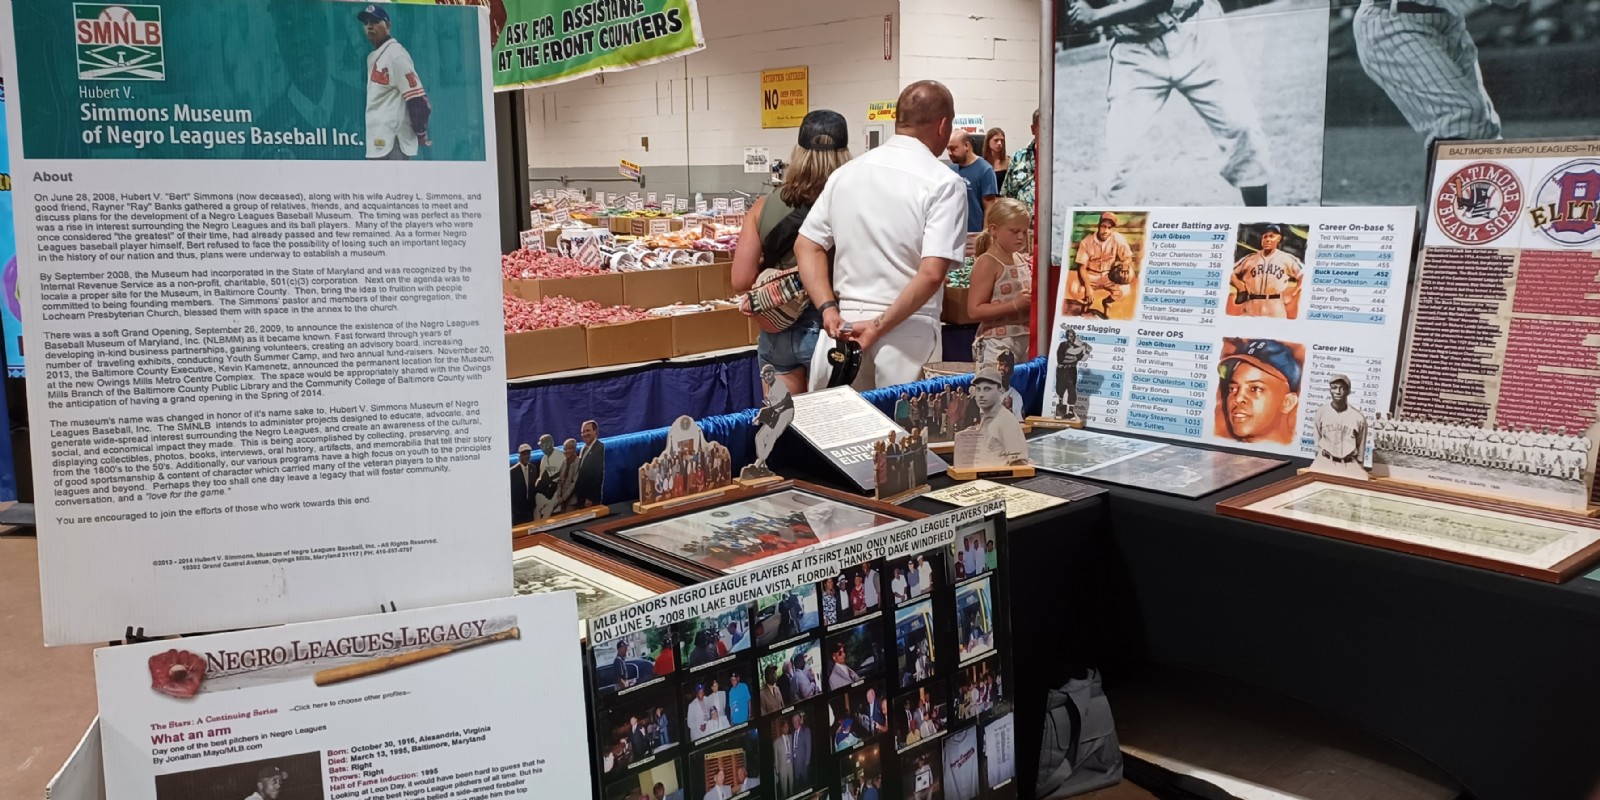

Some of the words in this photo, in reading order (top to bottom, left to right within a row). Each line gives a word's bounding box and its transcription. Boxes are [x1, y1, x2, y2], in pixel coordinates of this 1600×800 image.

[77, 20, 161, 45] SMNLB
[499, 50, 512, 71] AT
[517, 45, 539, 68] THE
[543, 31, 595, 64] FRONT
[600, 9, 683, 49] COUNTERS
[506, 22, 528, 46] ASK
[533, 16, 553, 40] FOR
[79, 85, 119, 99] Hubert
[122, 86, 135, 99] V.
[765, 89, 778, 110] NO
[80, 103, 169, 122] Simmons
[174, 104, 252, 122] Museum
[82, 125, 102, 144] of
[107, 126, 164, 148] Negro
[170, 126, 245, 149] Leagues
[251, 127, 326, 145] Baseball
[333, 128, 364, 146] Inc.
[1449, 147, 1502, 155] BALTIMORE'S
[33, 170, 73, 183] About
[1440, 166, 1520, 202] BALTIMORE
[1182, 222, 1212, 230] Batting
[1440, 207, 1478, 240] BLACK
[1486, 208, 1516, 235] SOX
[1251, 264, 1284, 279] GRAYS
[1087, 325, 1120, 334] Slugging
[1138, 329, 1164, 337] Career
[839, 453, 873, 465] ELITE
[94, 512, 147, 522] encouraged
[160, 509, 176, 519] join
[195, 506, 222, 515] efforts
[302, 499, 335, 508] towards
[338, 497, 351, 505] this
[594, 617, 617, 631] MLB
[620, 600, 667, 622] HONORS
[670, 588, 706, 606] NEGRO
[710, 576, 747, 596] LEAGUE
[750, 564, 788, 585] PLAYERS
[792, 560, 802, 571] AT
[805, 555, 818, 566] ITS
[819, 550, 841, 565] FIRST
[844, 544, 862, 557] AND
[867, 535, 887, 550] ONLY
[890, 527, 918, 545] NEGRO
[921, 518, 950, 534] LEAGUE
[952, 507, 981, 524] PLAYERS
[594, 632, 611, 644] ON
[614, 620, 642, 636] JUNE
[645, 615, 657, 628] 5,
[660, 610, 684, 626] 2008
[688, 605, 698, 617] IN
[702, 600, 726, 616] LAKE
[730, 588, 763, 607] BUENA
[765, 580, 795, 596] VISTA,
[798, 566, 838, 585] FLORDIA.
[838, 552, 872, 568] THANKS
[874, 547, 885, 557] TO
[888, 542, 909, 557] DAVE
[911, 530, 954, 552] WINDFIELD
[205, 646, 286, 672] NEGRO
[292, 632, 394, 661] LEAGUES
[400, 620, 486, 646] LEGACY
[150, 723, 166, 731] The
[168, 719, 194, 729] Stars:
[206, 711, 250, 723] Continuing
[253, 707, 278, 716] Series
[151, 732, 185, 745] What
[188, 731, 203, 740] an
[207, 726, 231, 737] arm
[152, 747, 168, 757] Day
[211, 738, 227, 747] best
[229, 734, 259, 745] pitchers
[270, 730, 293, 740] Negro
[295, 724, 327, 735] Leagues
[327, 748, 349, 757] Born:
[351, 743, 382, 753] October
[384, 740, 396, 749] 30,
[398, 737, 418, 746] 1916,
[419, 731, 461, 743] Alexandria,
[463, 725, 491, 736] Virginia
[166, 752, 201, 762] Jonathan
[203, 743, 263, 757] Mayo/MLB.com
[328, 757, 348, 765] Died:
[350, 753, 374, 762] March
[376, 751, 388, 759] 13,
[412, 741, 450, 752] Baltimore,
[452, 735, 486, 746] Maryland
[329, 765, 349, 774] Bats:
[351, 762, 372, 771] Right
[329, 773, 360, 782] Throws:
[363, 768, 384, 778] Right
[330, 782, 346, 791] Hall
[357, 777, 379, 787] Fame
[380, 771, 418, 783] Induction:
